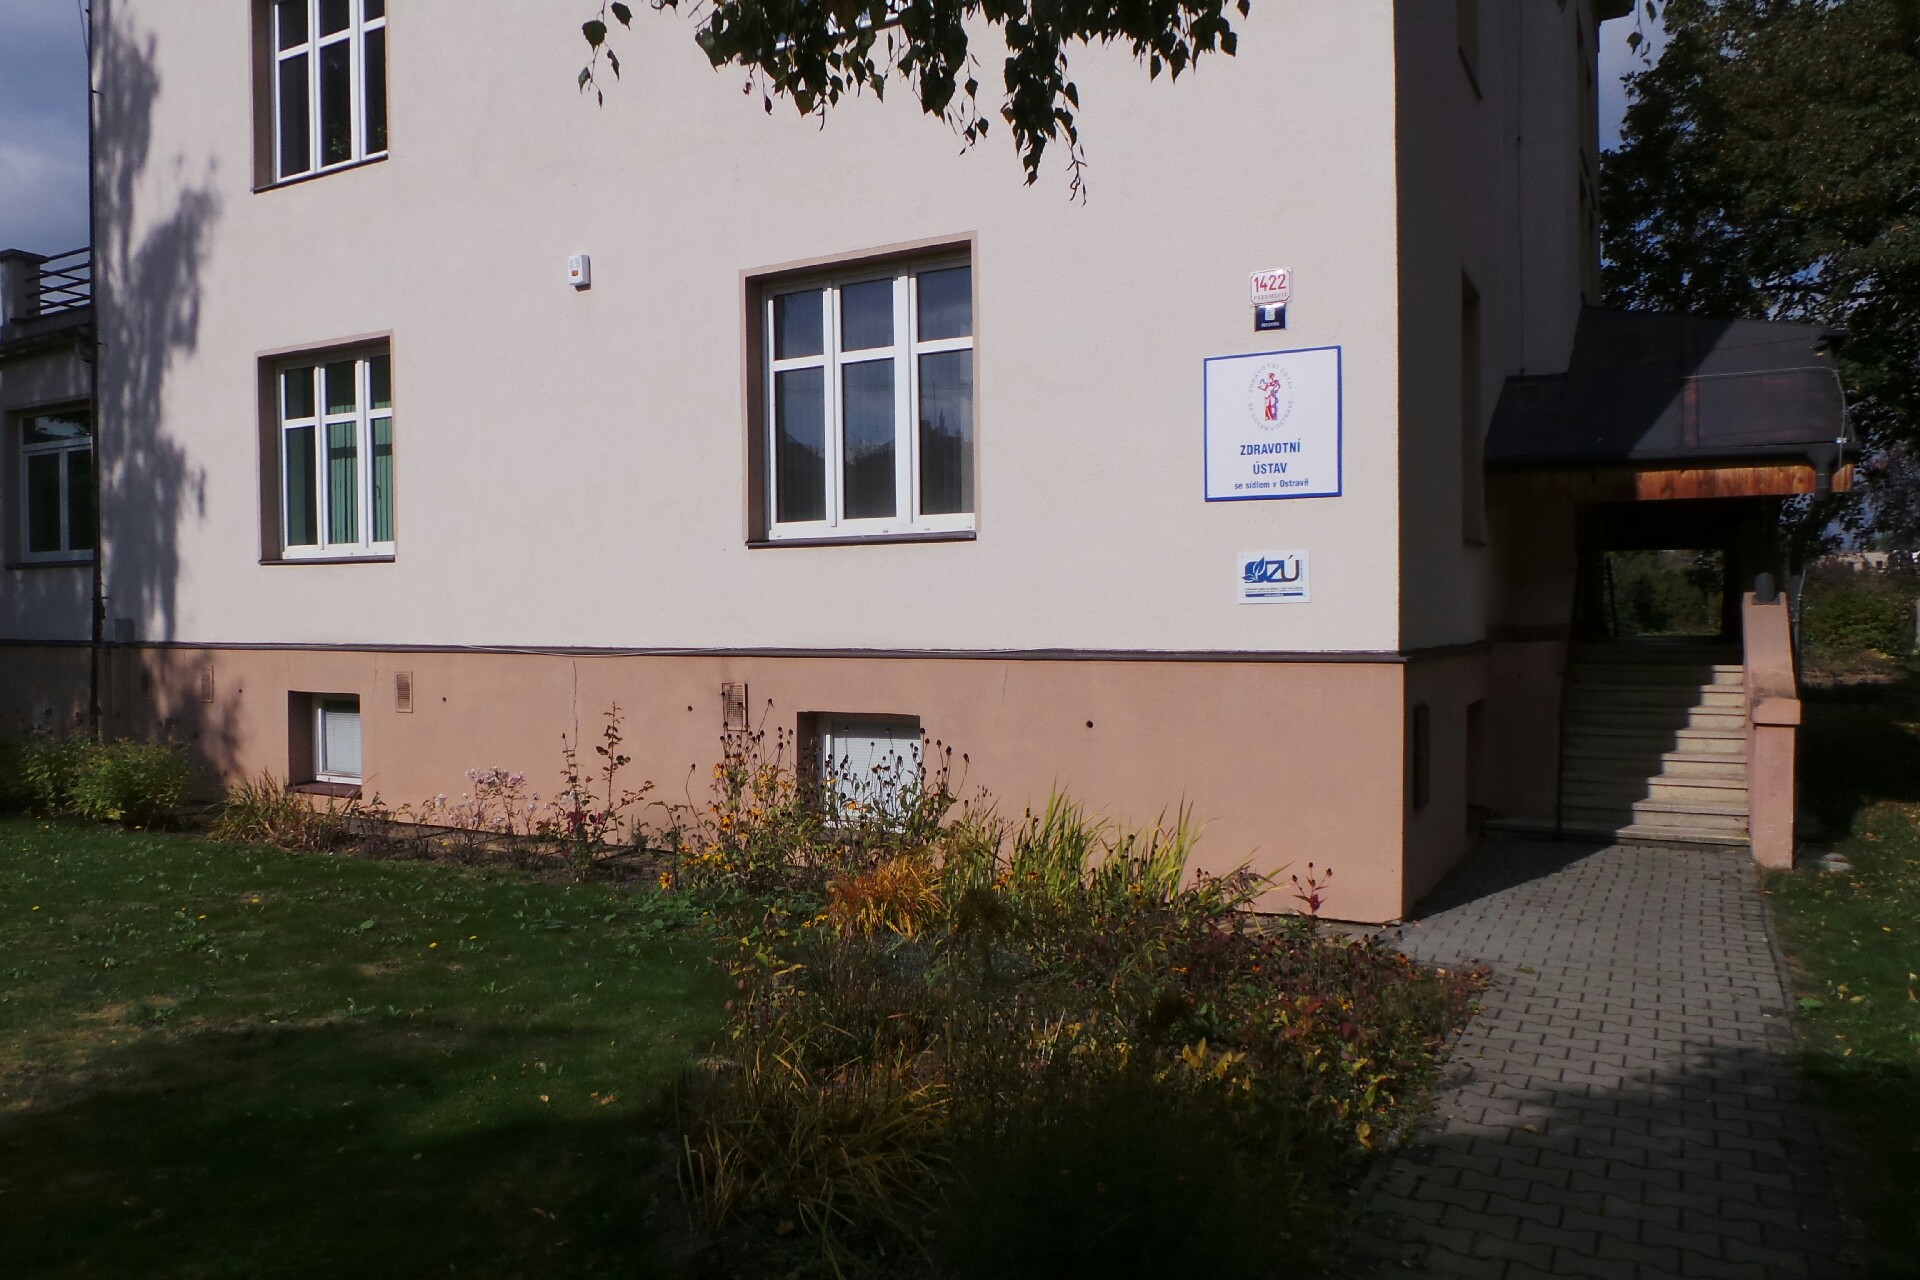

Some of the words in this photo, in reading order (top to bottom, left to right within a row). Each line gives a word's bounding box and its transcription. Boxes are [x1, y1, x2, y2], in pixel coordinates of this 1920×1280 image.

[1254, 274, 1287, 293] 1422
[1240, 438, 1301, 456] ZDRAVOTNÍ
[1252, 460, 1288, 475] ÚSTAV
[1234, 482, 1243, 490] se
[1245, 480, 1270, 489] sídlem
[1280, 478, 1309, 488] Ostravě
